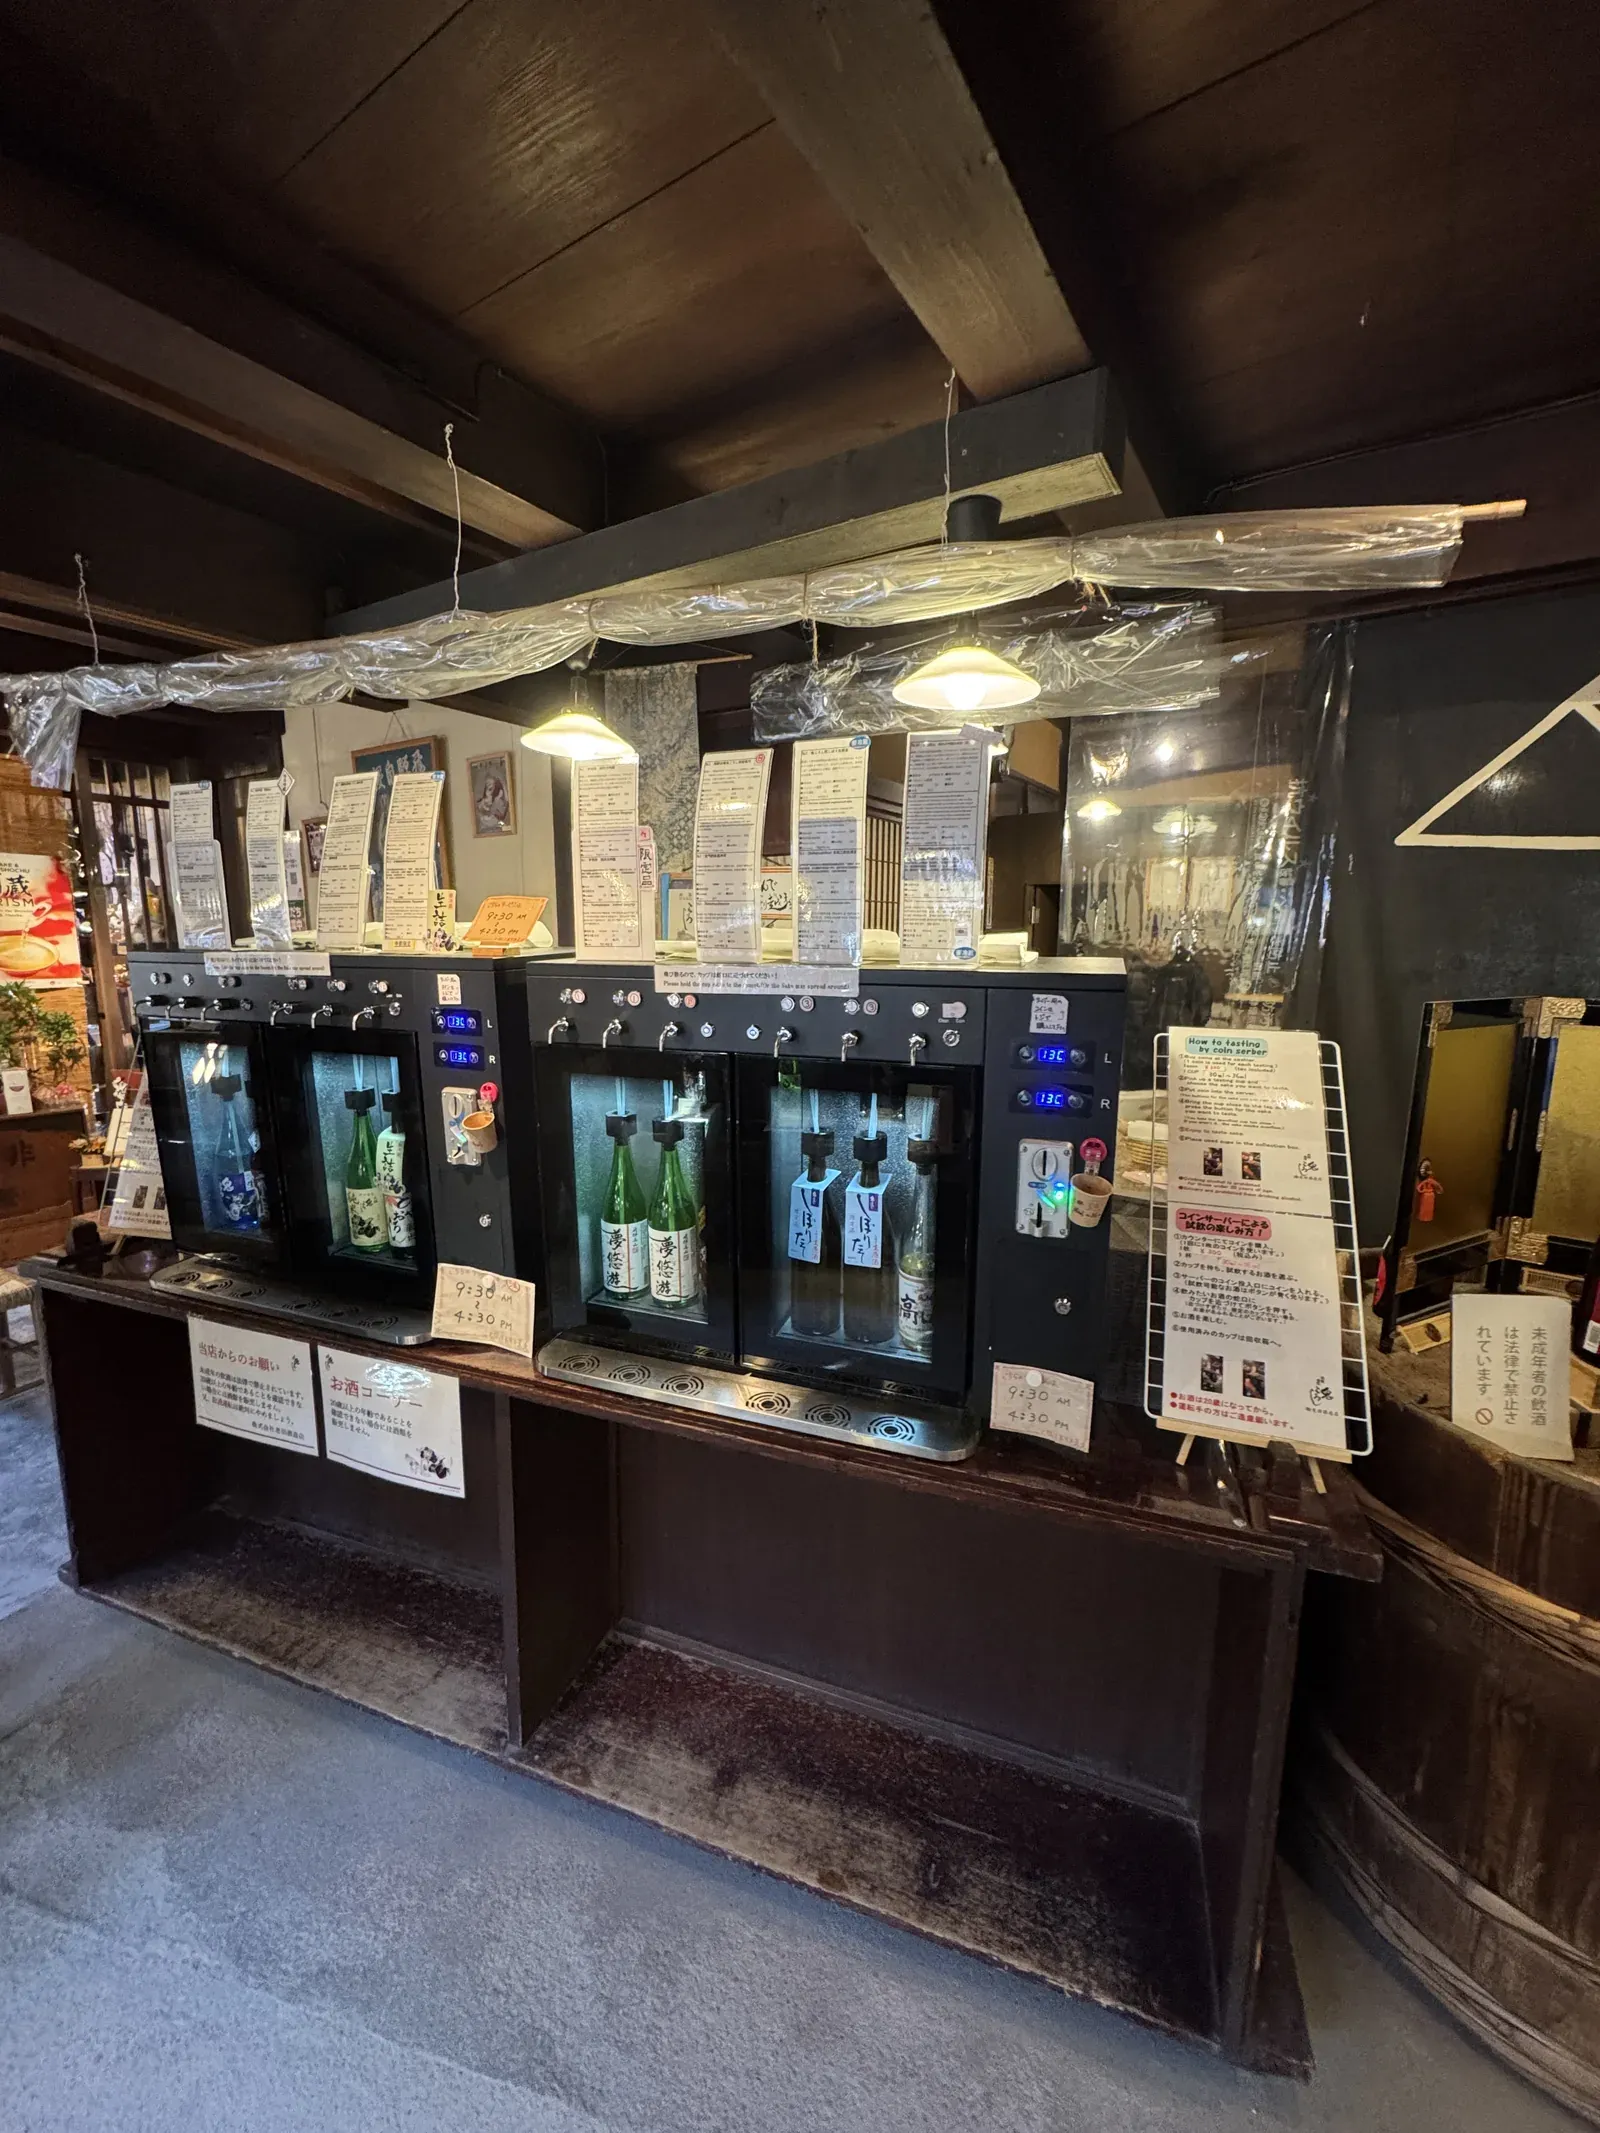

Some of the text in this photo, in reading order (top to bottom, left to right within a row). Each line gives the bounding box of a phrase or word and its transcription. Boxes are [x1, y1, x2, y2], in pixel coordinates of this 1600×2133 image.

[640, 848, 653, 886] 限定品
[0, 875, 32, 897] 蔵
[487, 912, 513, 920] 9:30
[487, 1020, 492, 1028] L
[1226, 1040, 1260, 1048] tasting
[1236, 1048, 1267, 1056] serber
[489, 1055, 495, 1064] R
[1043, 1050, 1064, 1060] 13C
[1104, 1053, 1112, 1063] L
[1040, 1094, 1061, 1104] 13C
[1100, 1099, 1110, 1109] R
[795, 1188, 816, 1258] しぼりたて
[852, 1193, 875, 1264] しぼりたて
[1179, 1212, 1269, 1229] コインサーバーによる
[1186, 1221, 1263, 1237] 試飲の楽しみ方！
[456, 1282, 494, 1299] 9:30
[501, 1296, 512, 1304] AM
[454, 1311, 512, 1330] 4:30 PM
[1172, 1311, 1227, 1325] ⑤お酒を楽しむ。
[1172, 1324, 1282, 1347] ⑥使用済みのカップは回収箱へ。
[199, 1342, 279, 1372] 当店からのお願い
[1476, 1326, 1494, 1403] れています。
[1504, 1326, 1521, 1425] は法律で禁止さ
[1531, 1327, 1548, 1426] 未成年者の飲酒
[331, 1376, 423, 1408] お酒コーナー
[1009, 1386, 1071, 1407] 9:30 AM
[330, 1399, 412, 1429] 20歳以上の年齢であることを
[1179, 1393, 1274, 1416] お酒は20歳になってから。
[331, 1409, 412, 1439] 確認できない場合には酒類を
[332, 1417, 370, 1437] 販売しません。
[1008, 1411, 1068, 1431] 4:30 PM
